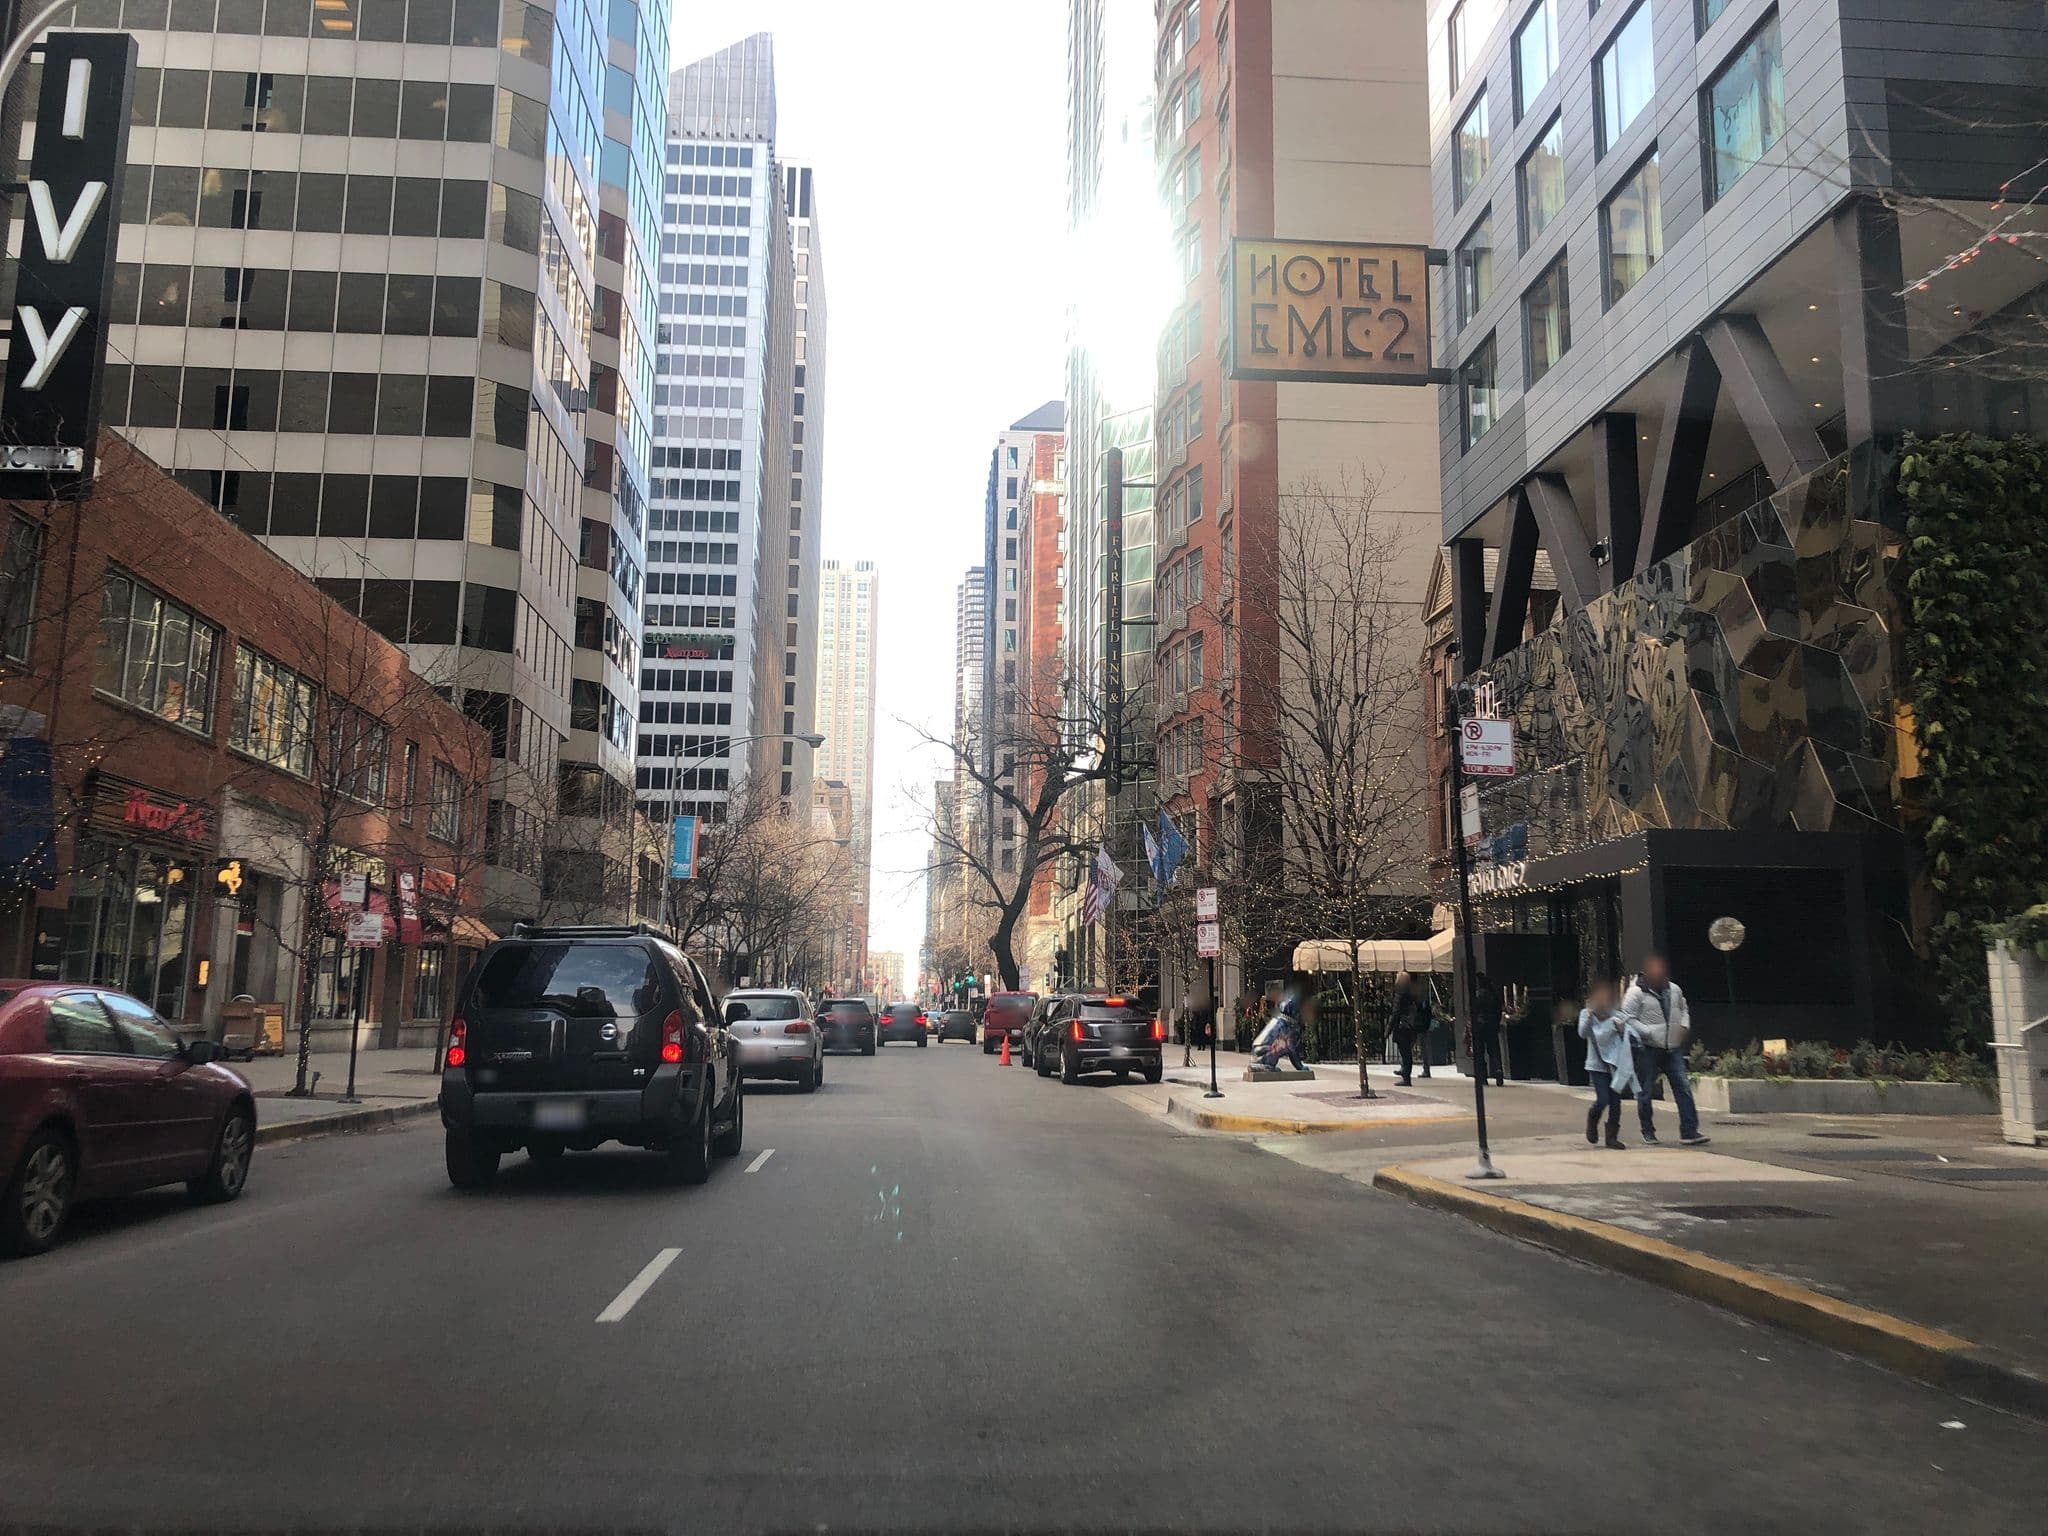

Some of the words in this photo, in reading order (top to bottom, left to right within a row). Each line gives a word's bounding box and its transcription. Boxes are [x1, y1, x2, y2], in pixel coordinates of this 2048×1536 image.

[1251, 254, 1412, 303] HOTEL
[1251, 304, 1414, 360] EMC2
[1110, 535, 1121, 643] FAIRFIELD
[1109, 649, 1120, 685] INN
[1109, 693, 1119, 704] &
[1465, 764, 1484, 773] TOW
[1487, 766, 1511, 774] ZONE
